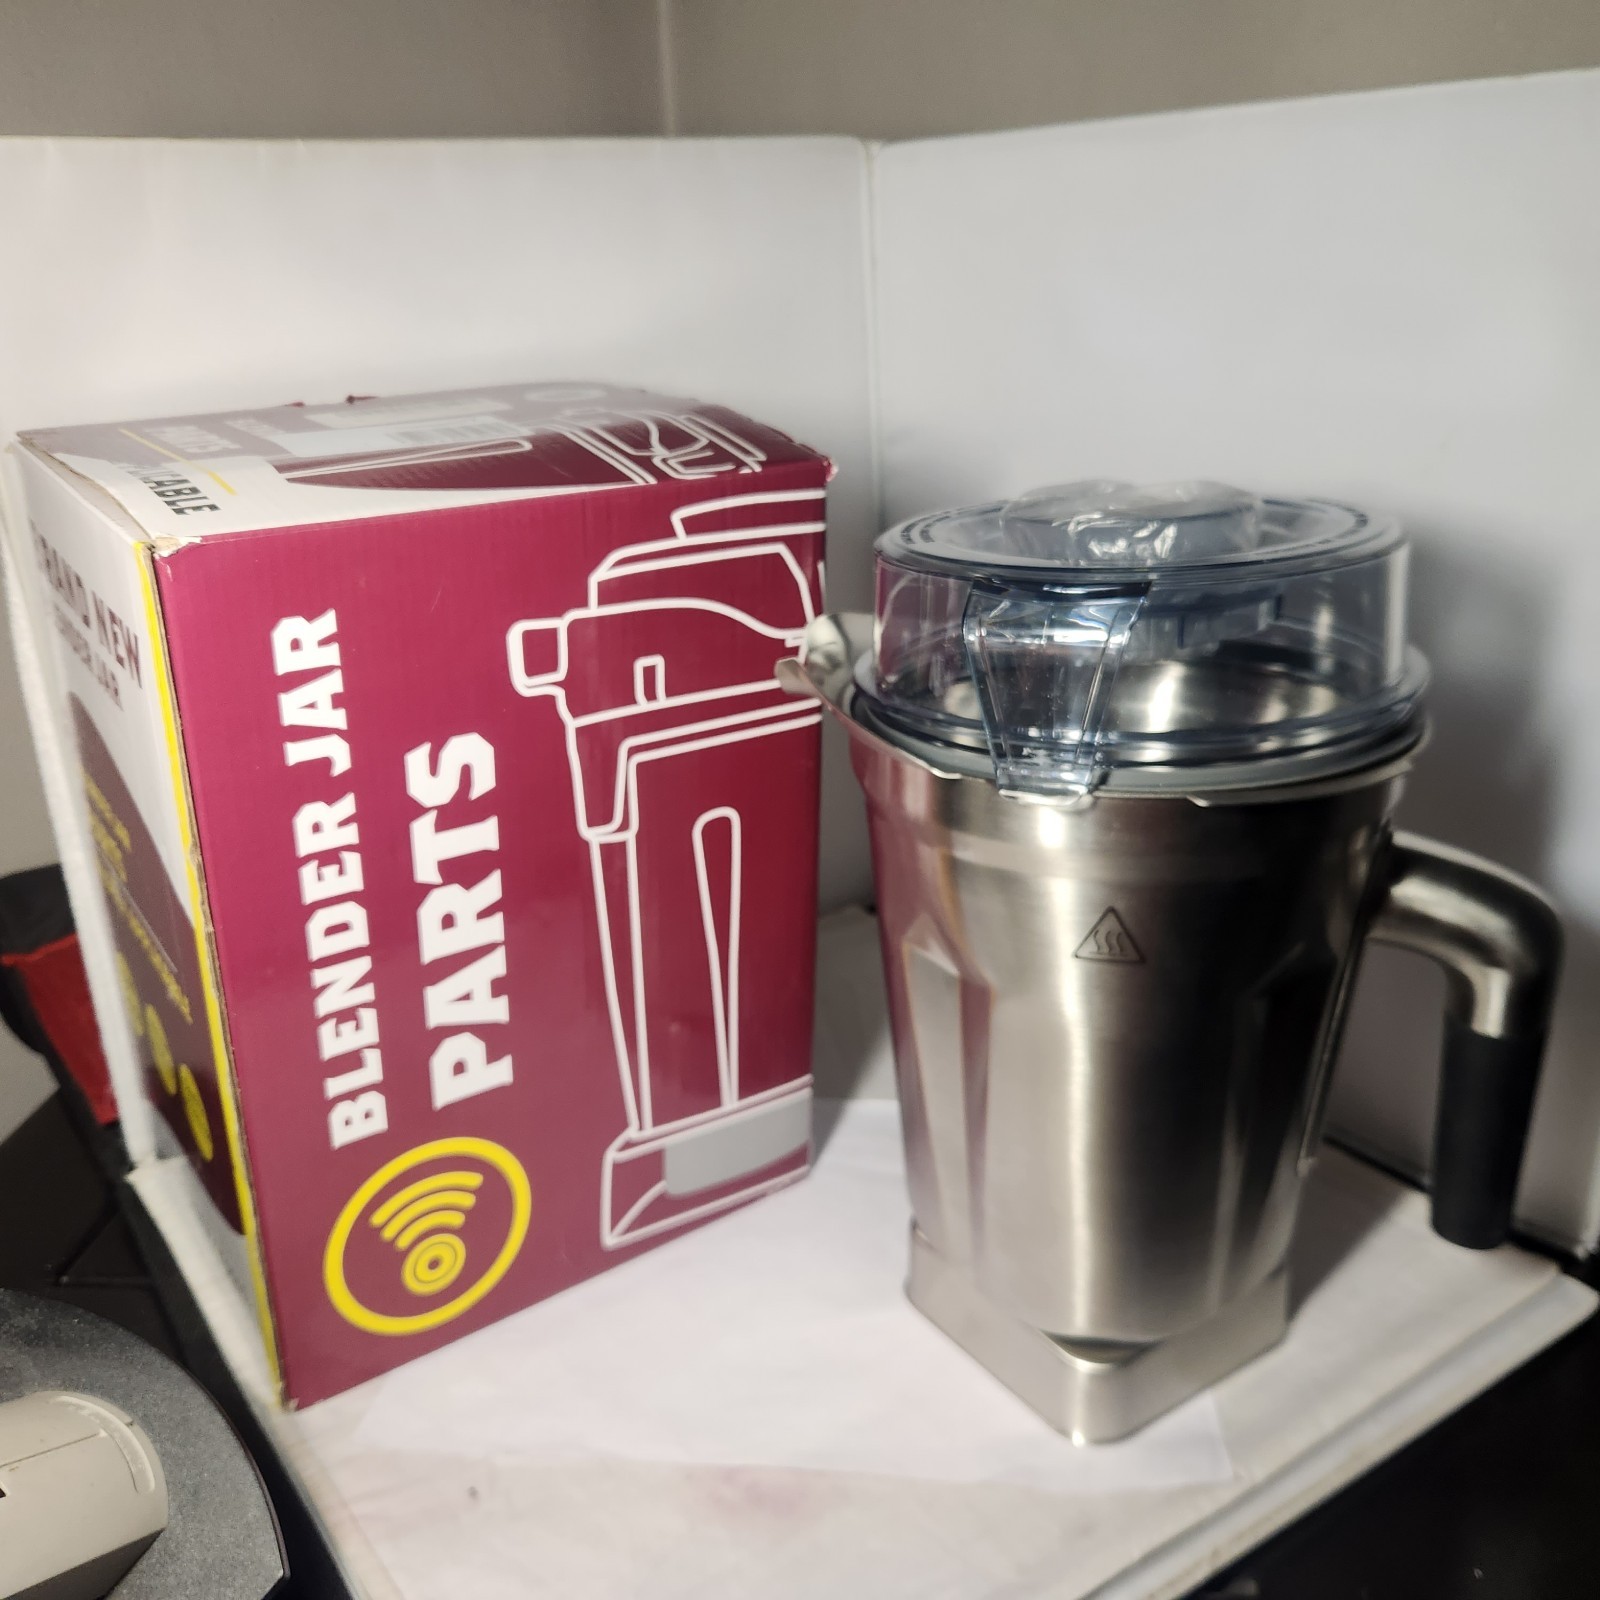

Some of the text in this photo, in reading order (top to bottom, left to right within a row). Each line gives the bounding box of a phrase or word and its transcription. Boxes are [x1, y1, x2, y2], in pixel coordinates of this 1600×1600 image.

[91, 590, 143, 690] NEW
[270, 607, 389, 1150] BLENDER JAR
[404, 731, 514, 1111] PARTS
